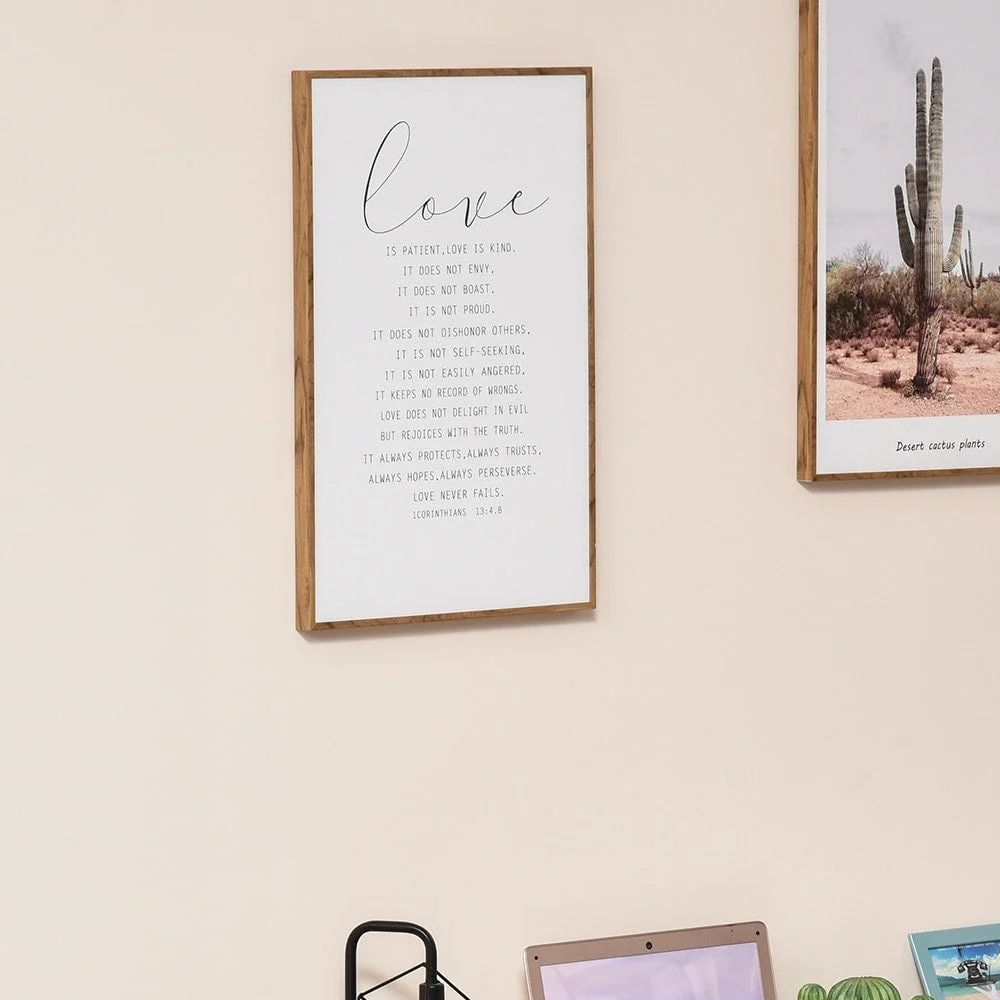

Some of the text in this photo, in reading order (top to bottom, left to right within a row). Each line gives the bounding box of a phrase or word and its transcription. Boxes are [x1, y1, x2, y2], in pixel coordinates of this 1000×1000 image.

[363, 121, 549, 234] love
[385, 245, 397, 257] IS
[473, 242, 485, 254] IS
[489, 242, 517, 254] KIND.
[402, 264, 496, 277] IT DOES NOT ENVY.
[398, 283, 496, 297] IT DOES NOT BOAST.
[408, 303, 496, 317] IT IS NOT PROUD.
[372, 324, 532, 341] IT DOES NOT DISHONOR OTHERS.
[395, 344, 526, 360] IT IS NOT SELF-SEEKING.
[384, 364, 526, 381] IT IS NOT EASILY ANGERED.
[376, 384, 524, 401] IT KEEPS NO RECORD OF WRONGS.
[380, 403, 529, 421] LOVE DOES NOT DELIGHT IN EVIL
[380, 424, 524, 442] BUT REJOICES WITH THE TRUTH.
[895, 437, 986, 452] Desert cactus plants
[363, 453, 374, 465] IT
[379, 451, 413, 464] ALWAYS
[505, 444, 542, 457] TRUSTS.
[368, 472, 403, 484] ALWAYS
[412, 487, 504, 503] LOVE NEVER FAILS.
